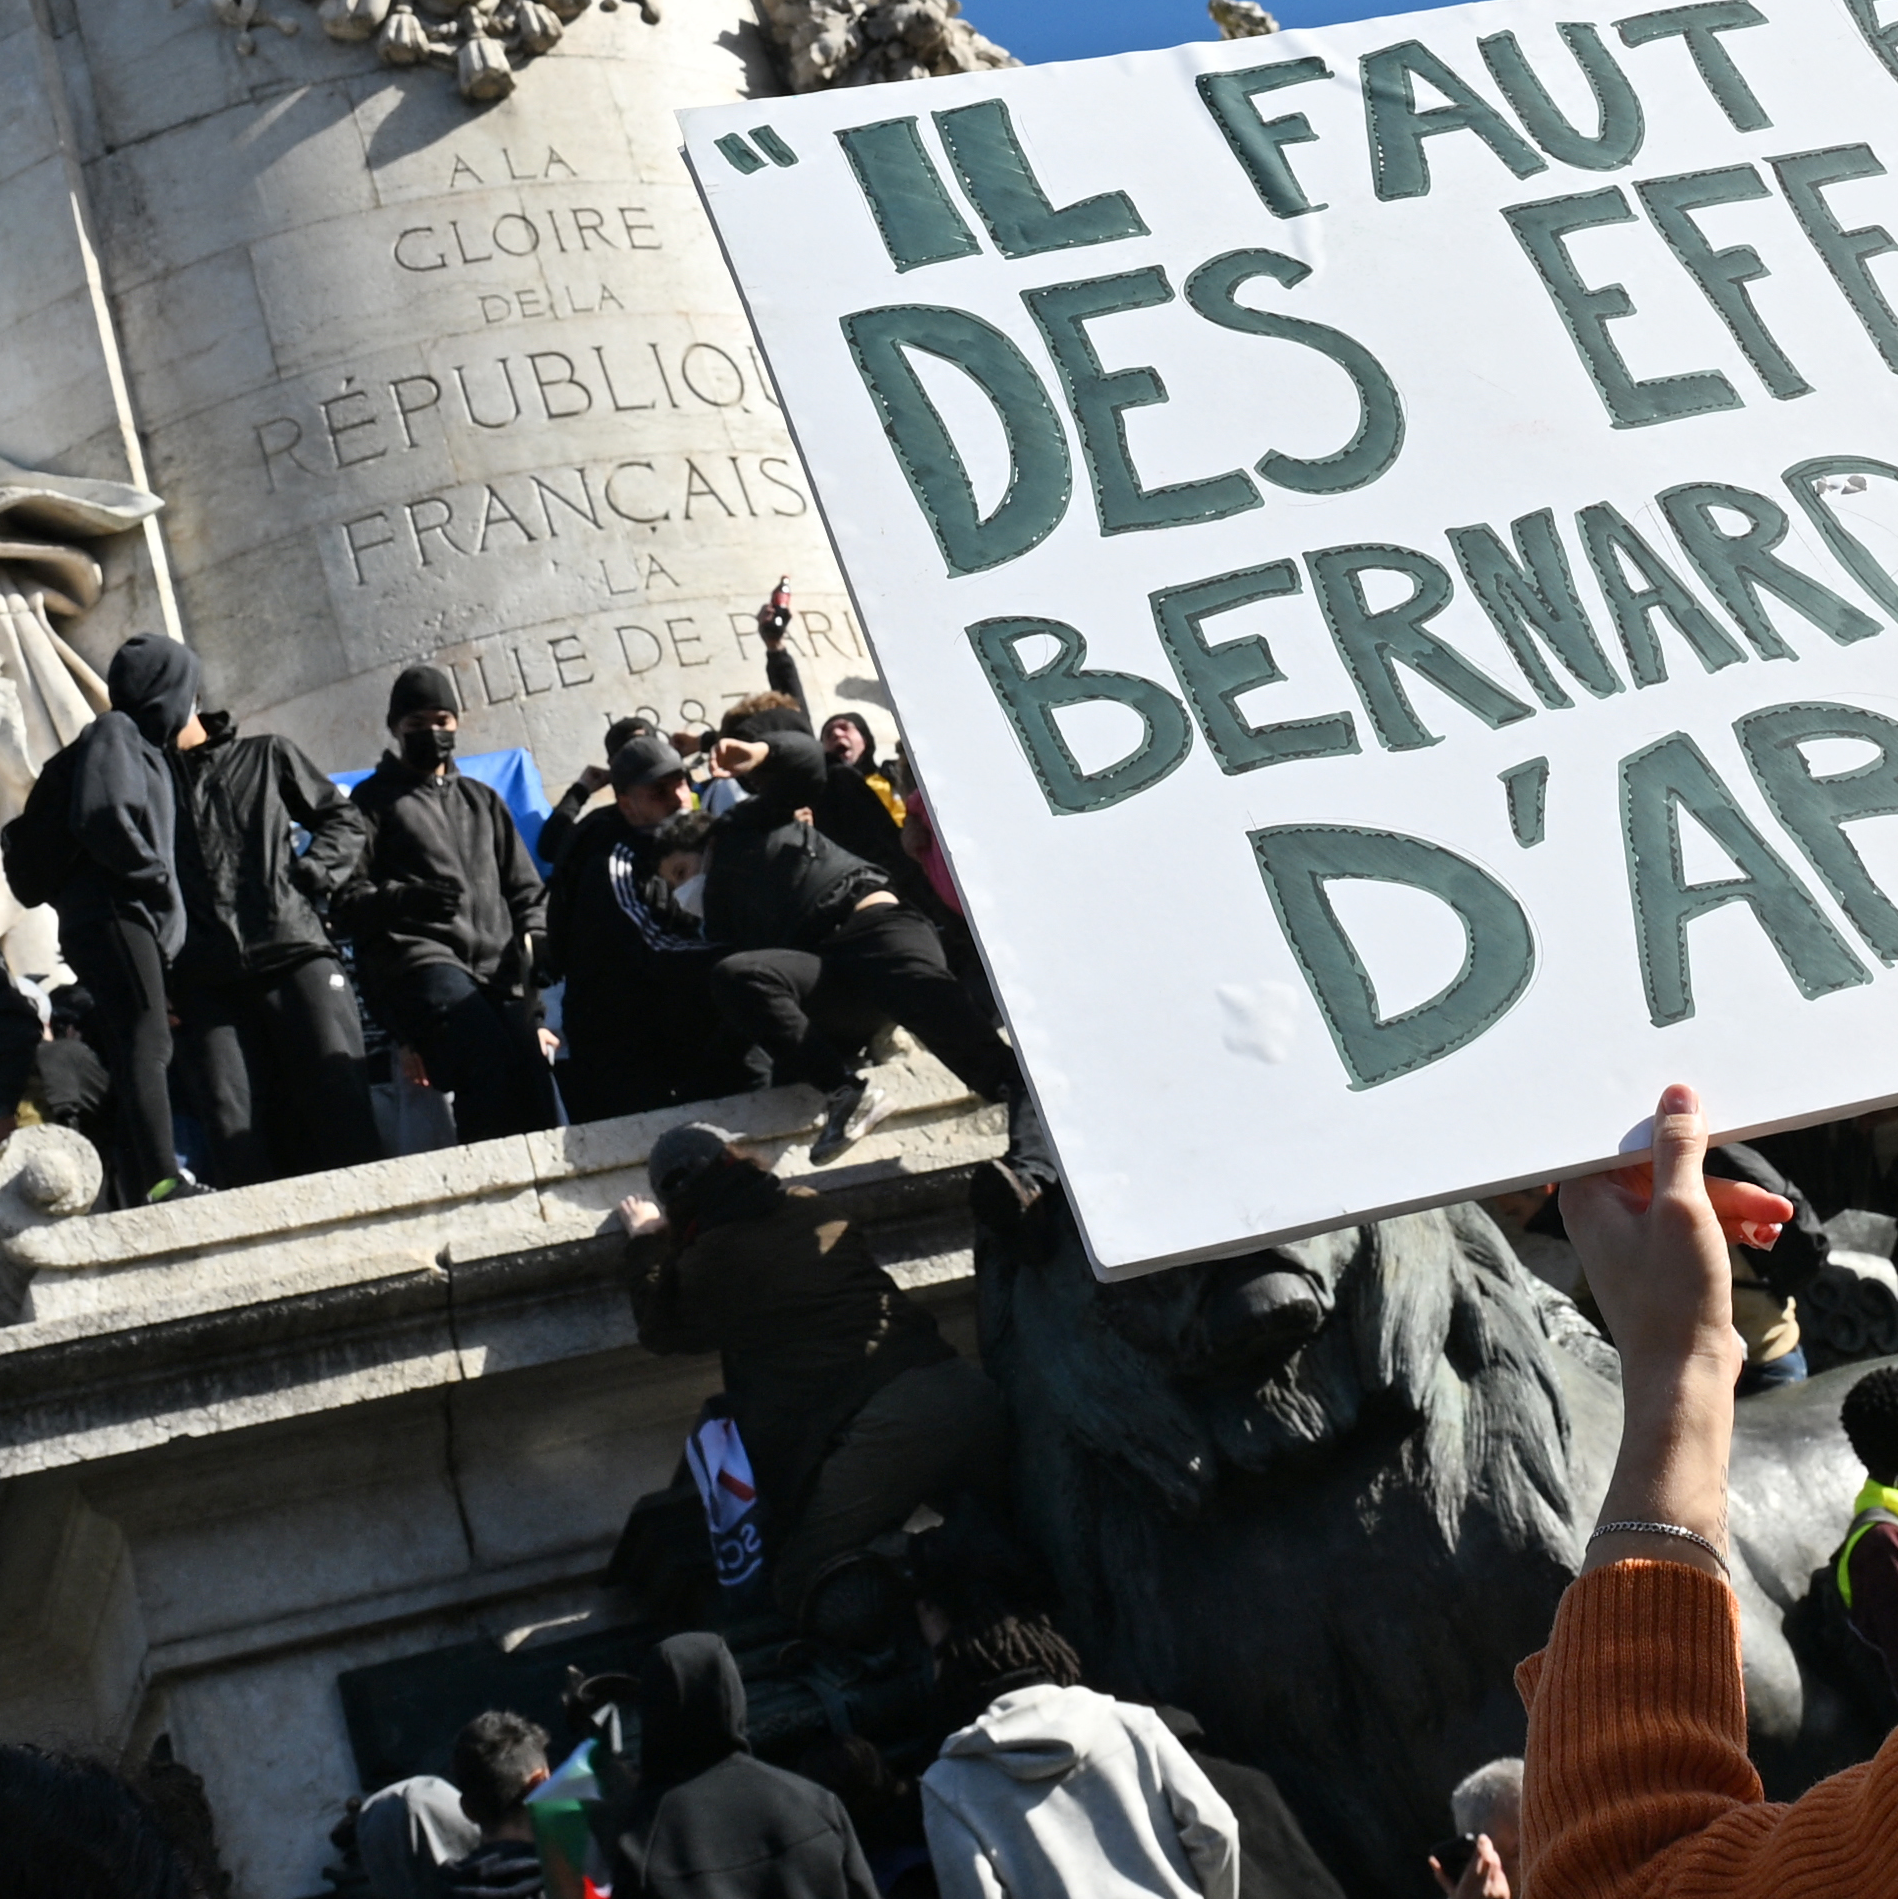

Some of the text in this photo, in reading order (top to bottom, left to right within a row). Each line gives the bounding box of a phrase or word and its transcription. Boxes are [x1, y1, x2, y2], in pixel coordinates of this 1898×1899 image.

[1196, 0, 1768, 220] FAUT
[450, 144, 578, 188] A LA
[393, 206, 663, 272] GLOIRE
[478, 283, 624, 324] DE LA
[840, 249, 1406, 579] DES
[340, 455, 807, 587] FRANÇAIS
[599, 553, 681, 596] LA
[445, 634, 595, 714] ILLE
[614, 616, 712, 676] DE
